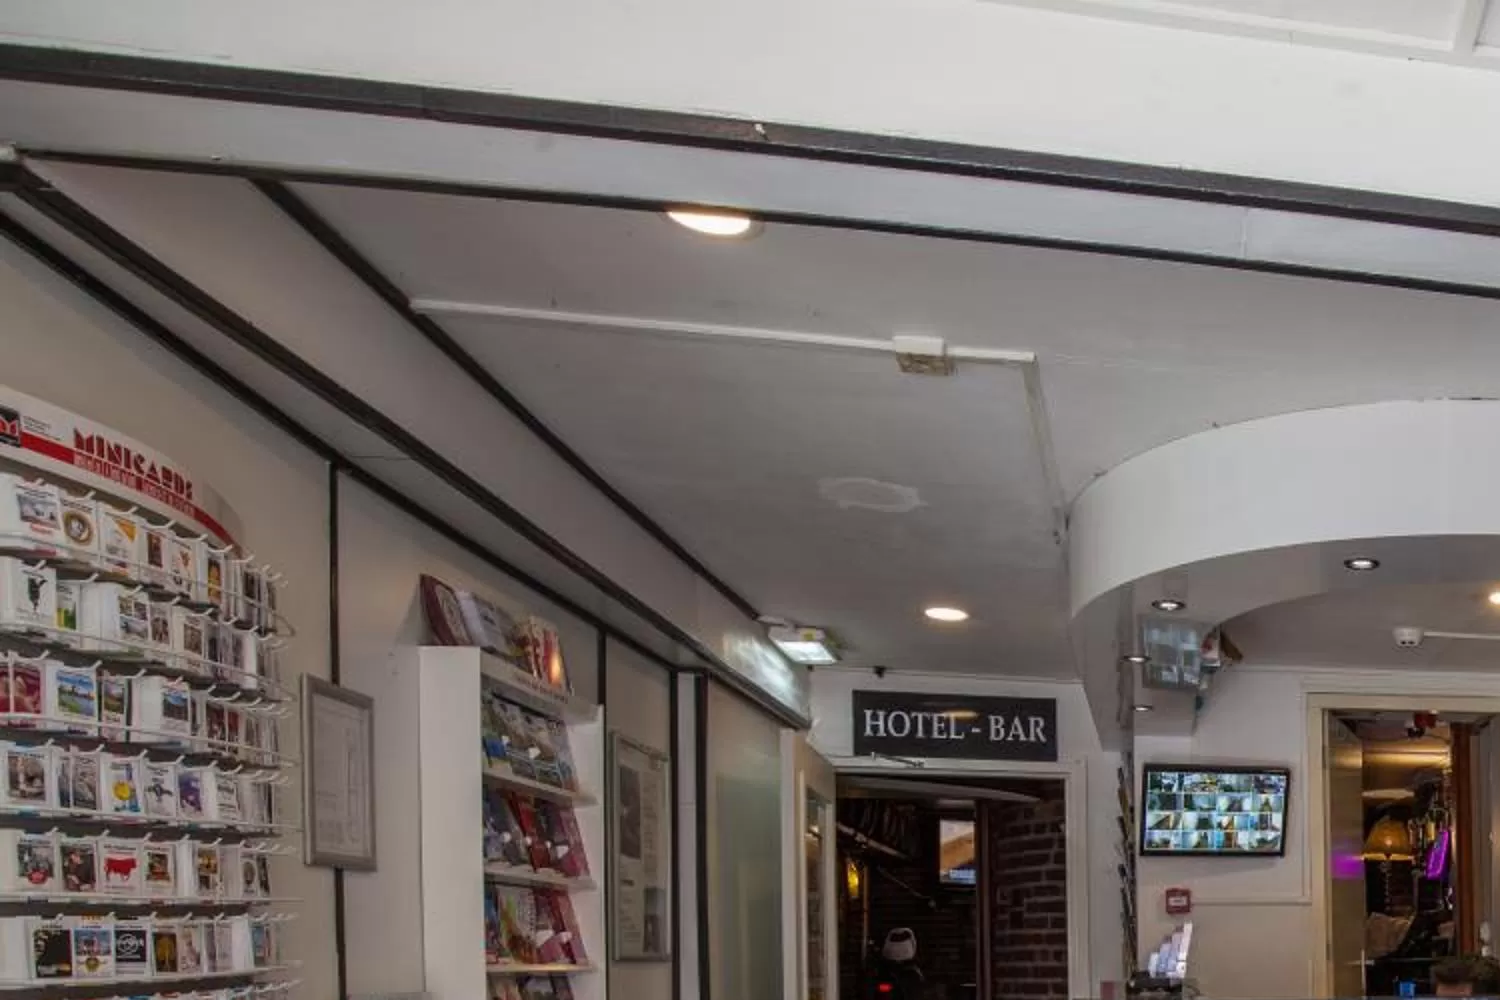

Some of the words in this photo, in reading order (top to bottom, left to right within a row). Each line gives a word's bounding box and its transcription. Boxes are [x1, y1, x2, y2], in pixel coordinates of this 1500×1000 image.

[74, 427, 193, 501] MINICARDS
[862, 709, 965, 740] HOTEL
[988, 714, 1047, 743] BAR
